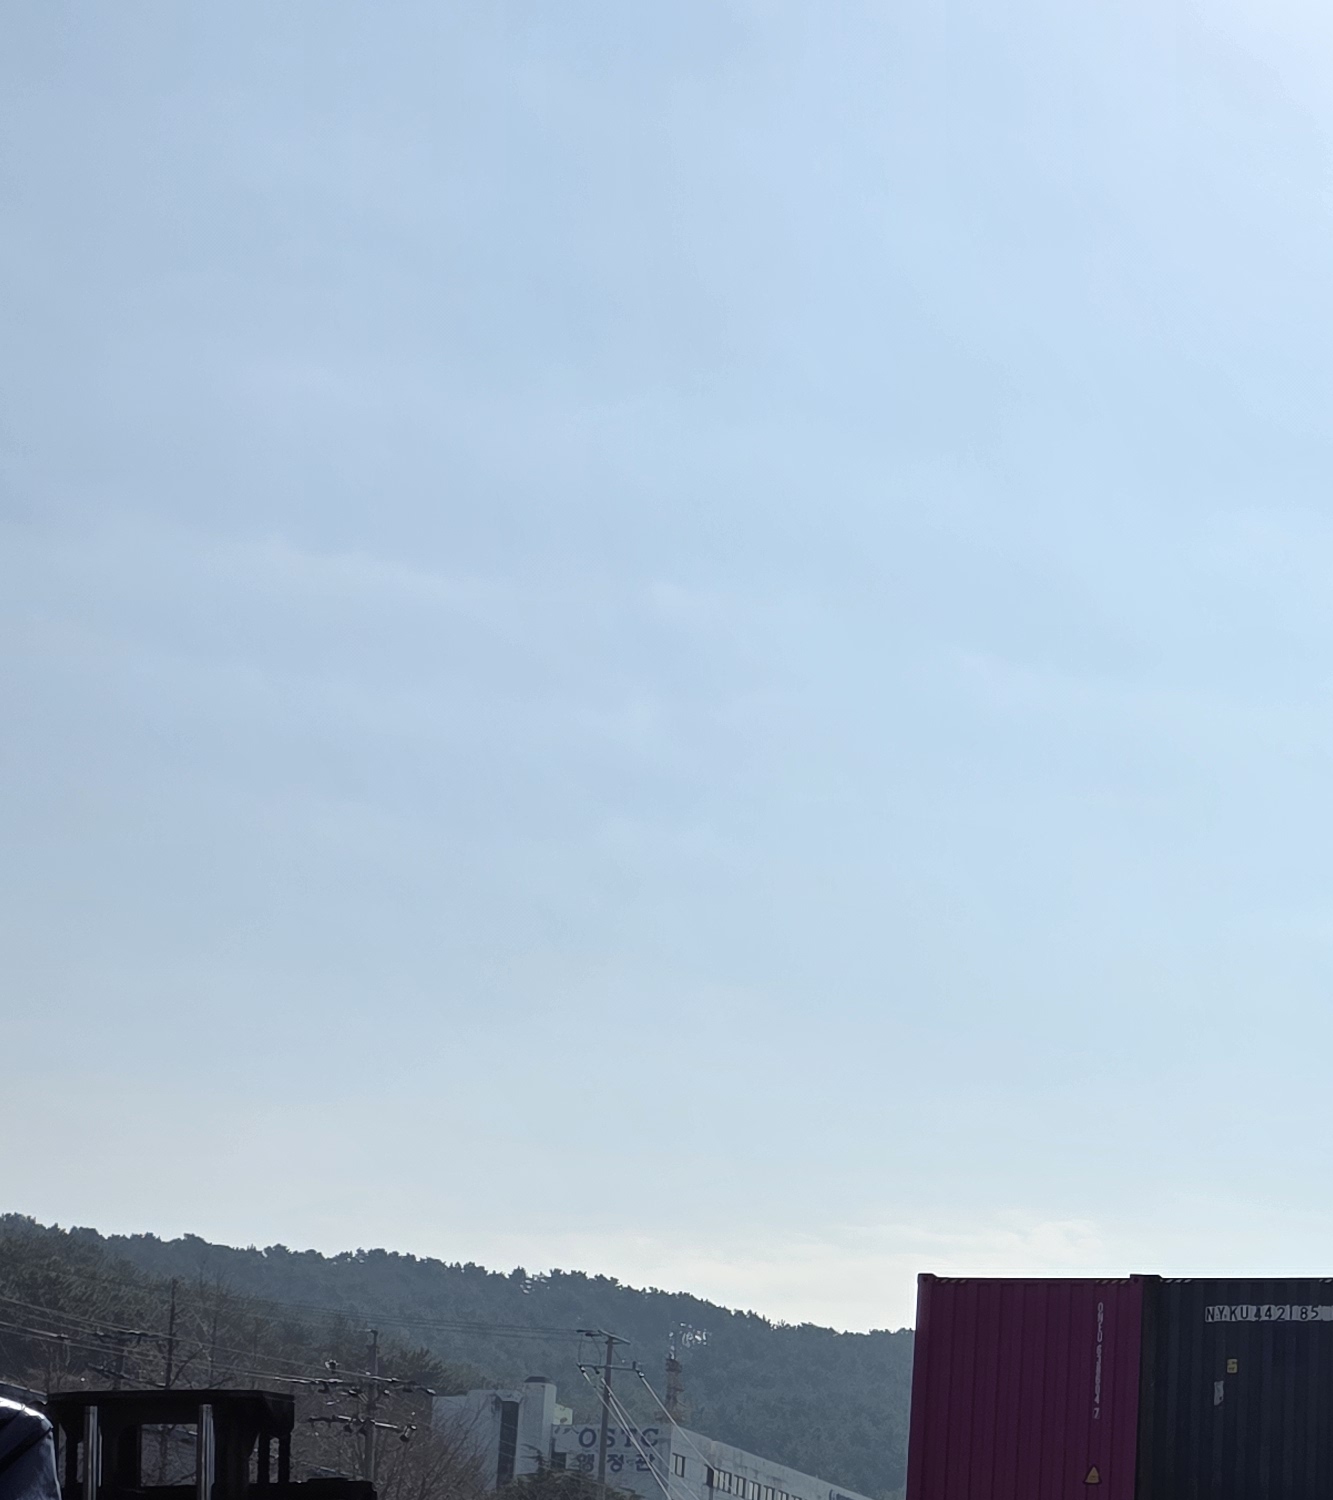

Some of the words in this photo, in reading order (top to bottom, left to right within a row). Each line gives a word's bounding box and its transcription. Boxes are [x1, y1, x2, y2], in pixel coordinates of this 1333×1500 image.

[1206, 1306, 1250, 1321] NYKU
[1254, 1306, 1320, 1321] 442185
[578, 1427, 660, 1449] OSTC
